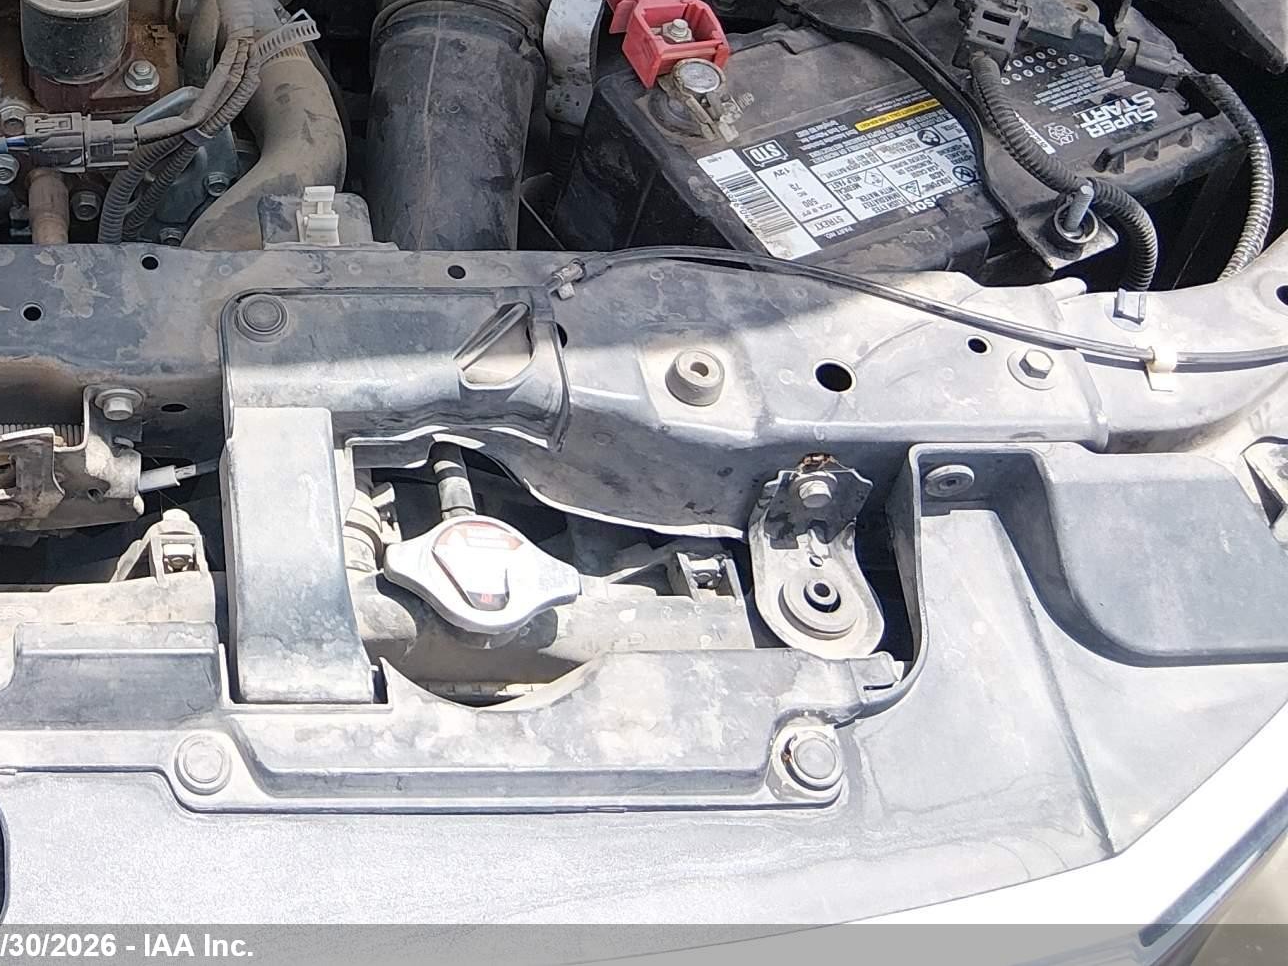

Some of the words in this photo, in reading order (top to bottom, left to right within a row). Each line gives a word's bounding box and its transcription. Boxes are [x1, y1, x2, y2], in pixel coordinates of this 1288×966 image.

[1080, 91, 1155, 128] START
[1085, 109, 1157, 138] SUPER
[747, 142, 782, 162] STD
[770, 166, 790, 177] 12V
[843, 173, 862, 184] HELP
[788, 182, 802, 191] 75
[833, 181, 862, 196] MEDICAL
[875, 184, 894, 195] WITH
[800, 197, 818, 207] 500
[860, 190, 900, 209] IMMEDIATELY
[886, 196, 906, 208] FLUSH
[817, 202, 833, 210] CCA
[871, 203, 888, 213] EYES
[823, 231, 836, 239] NO.
[834, 225, 853, 235] PART
